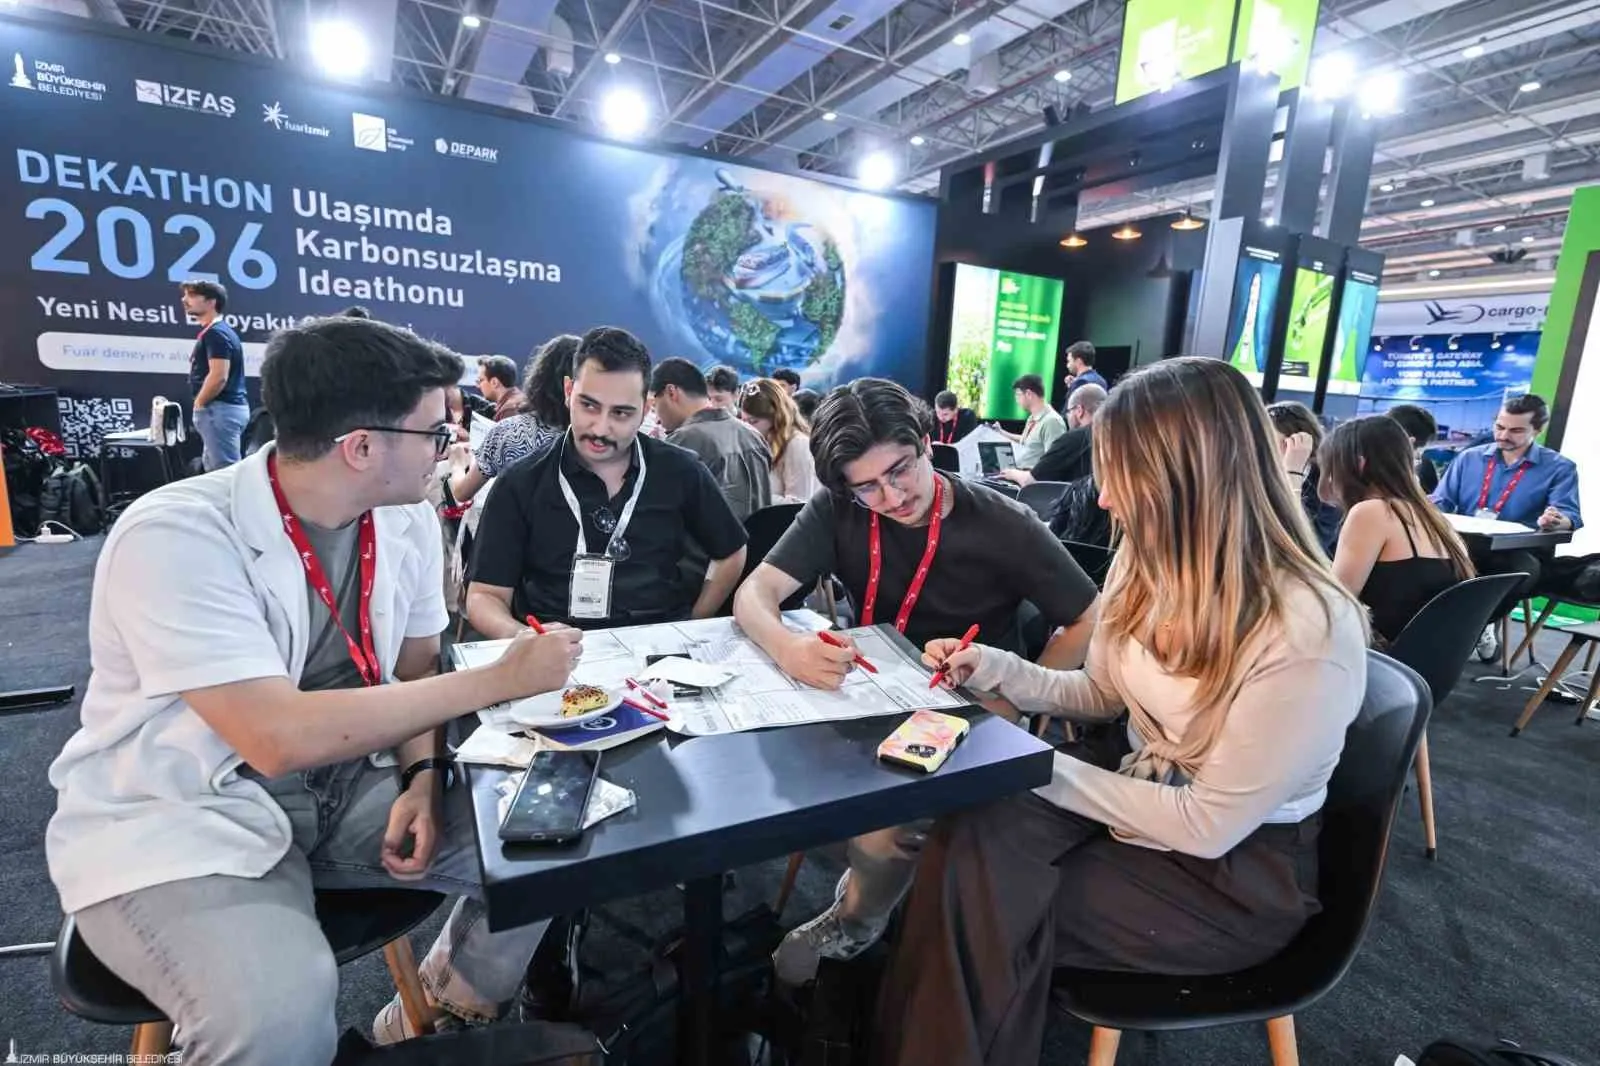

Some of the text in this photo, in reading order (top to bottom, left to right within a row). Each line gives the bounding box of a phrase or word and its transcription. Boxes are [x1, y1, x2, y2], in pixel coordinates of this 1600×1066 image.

[163, 84, 236, 118] İZFAŞ
[451, 142, 498, 160] DEPARK
[17, 148, 273, 213] DEKATHON
[292, 188, 452, 236] Ulaşımda
[25, 198, 277, 290] 2026
[296, 228, 561, 284] Karbonsuzlaşma
[299, 267, 464, 308] Ideathonu
[37, 296, 99, 320] Yeni
[107, 301, 178, 325] Nesil
[62, 344, 97, 358] Fuar
[107, 345, 166, 361] deneyim
